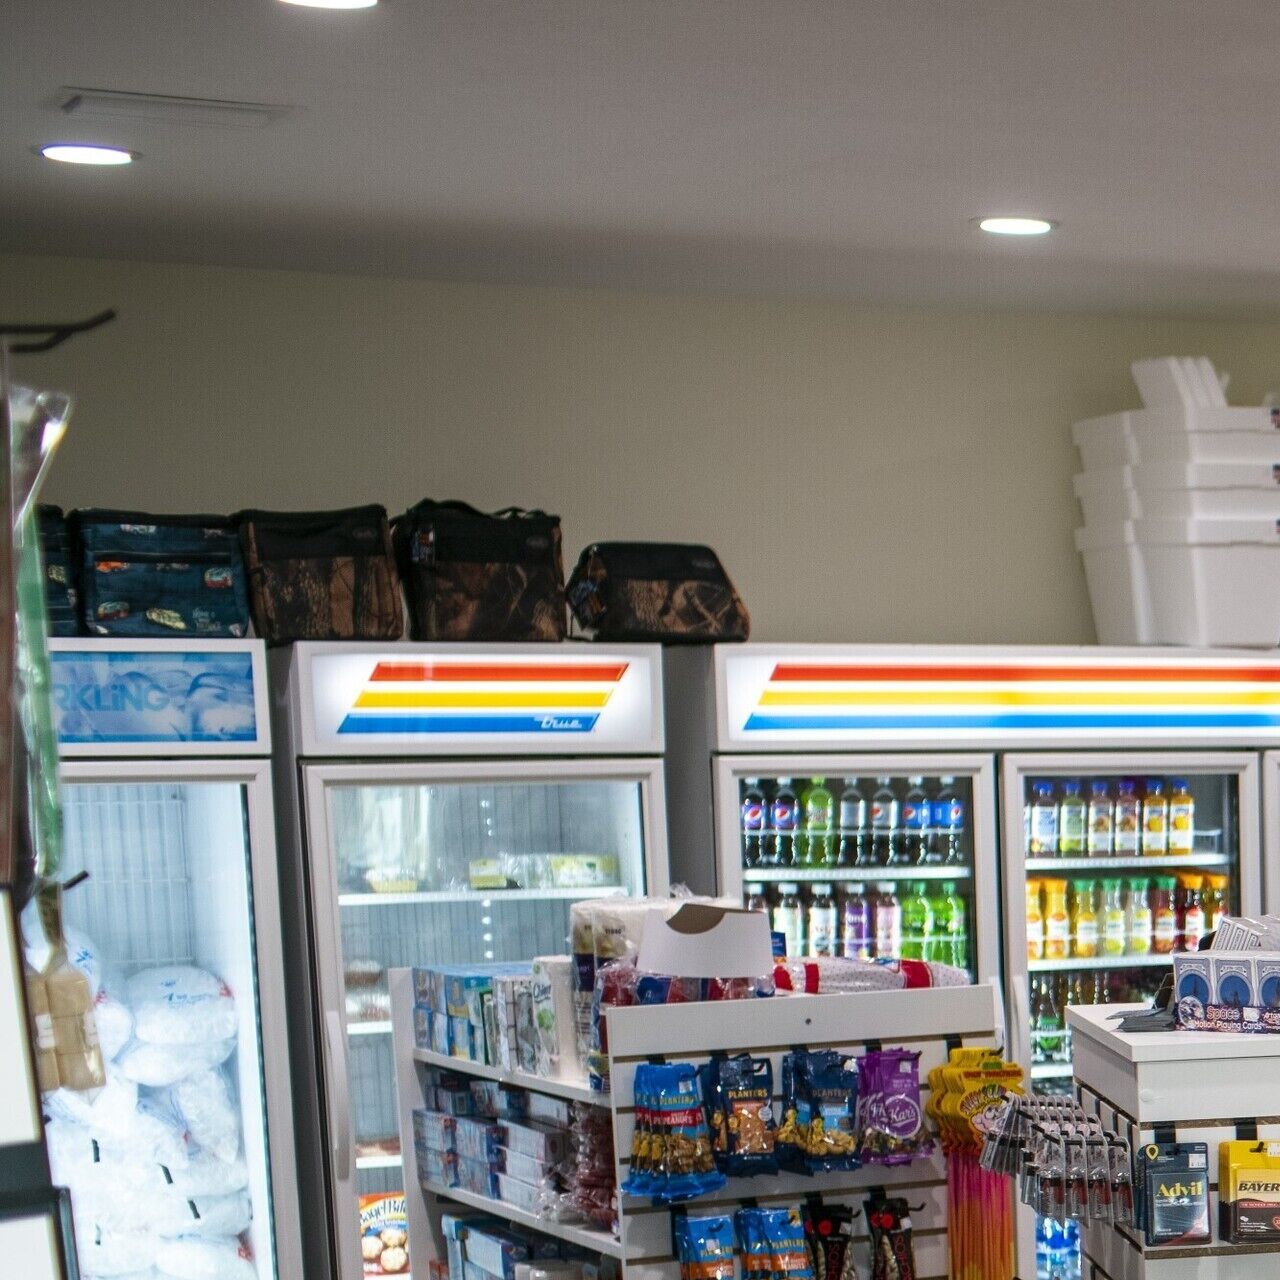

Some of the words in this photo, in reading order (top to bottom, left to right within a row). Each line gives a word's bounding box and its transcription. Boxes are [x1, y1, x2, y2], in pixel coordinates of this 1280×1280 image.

[534, 715, 582, 729] true
[1206, 1005, 1241, 1021] Space
[1216, 1020, 1241, 1030] Playing
[1243, 1020, 1262, 1029] Cards
[728, 1088, 768, 1099] PLANTERS
[1156, 1181, 1203, 1197] Advil
[1238, 1182, 1280, 1192] BAYER
